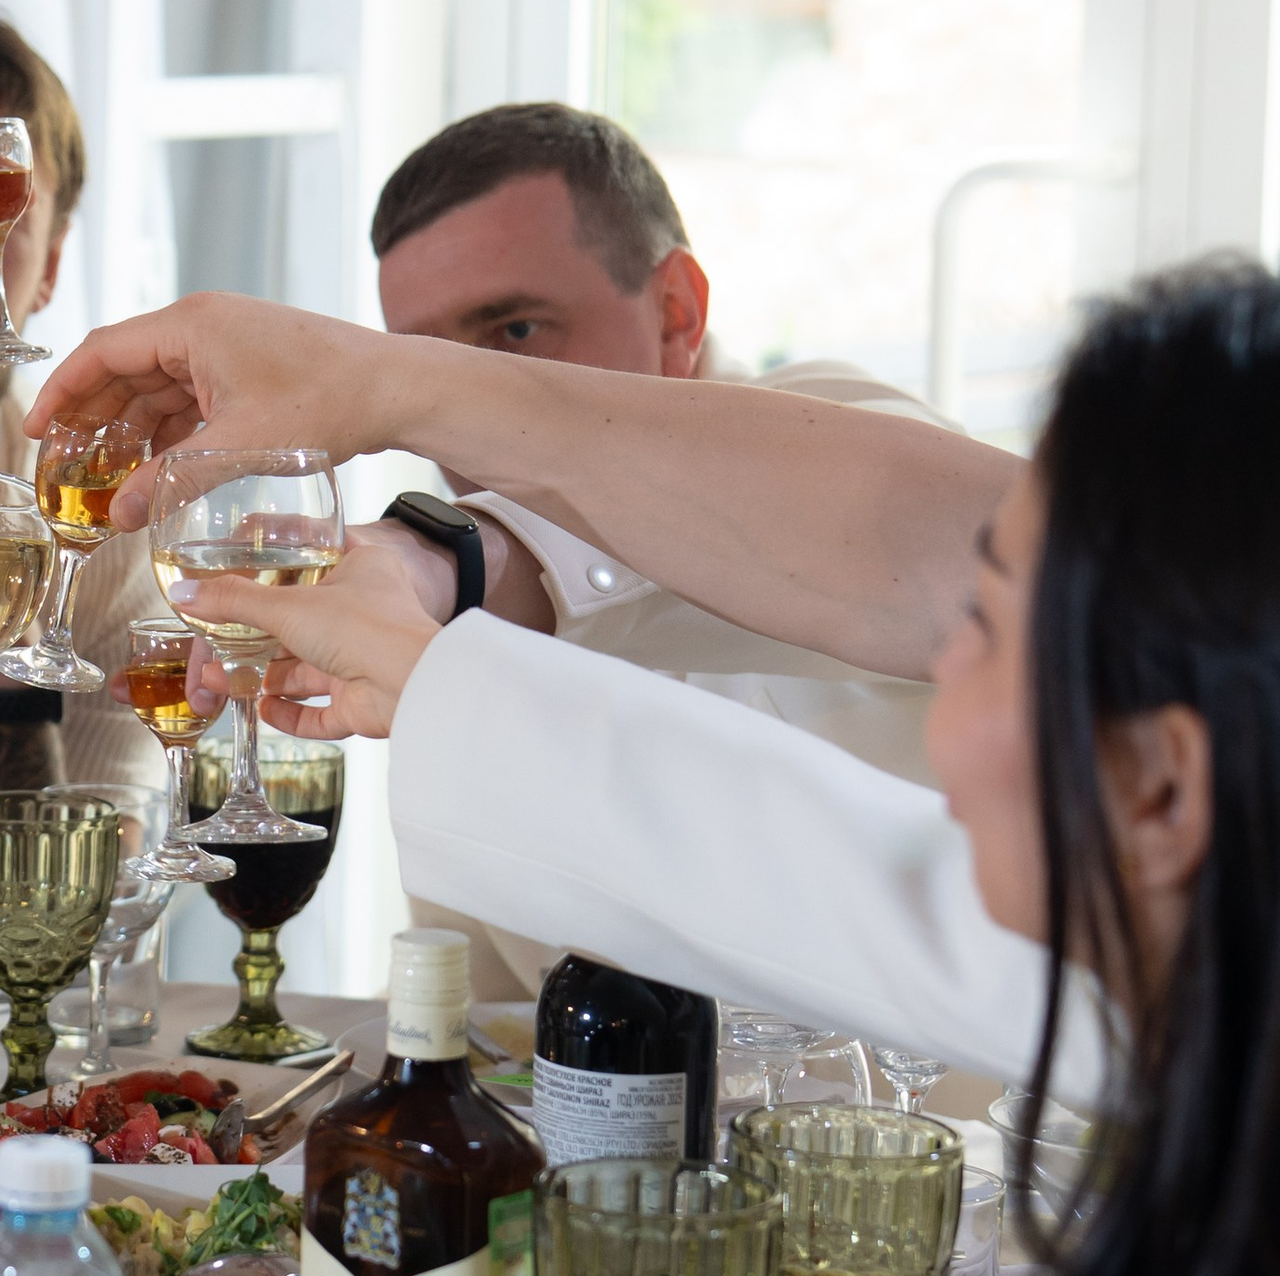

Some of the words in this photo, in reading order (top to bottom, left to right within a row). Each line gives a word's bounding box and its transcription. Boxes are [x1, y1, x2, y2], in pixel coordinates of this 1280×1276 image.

[577, 1074, 612, 1087] КРАСНОЕ
[576, 1085, 603, 1096] ШИРАЗ
[582, 1095, 610, 1108] SHIRAZ
[617, 1093, 632, 1108] ГОД
